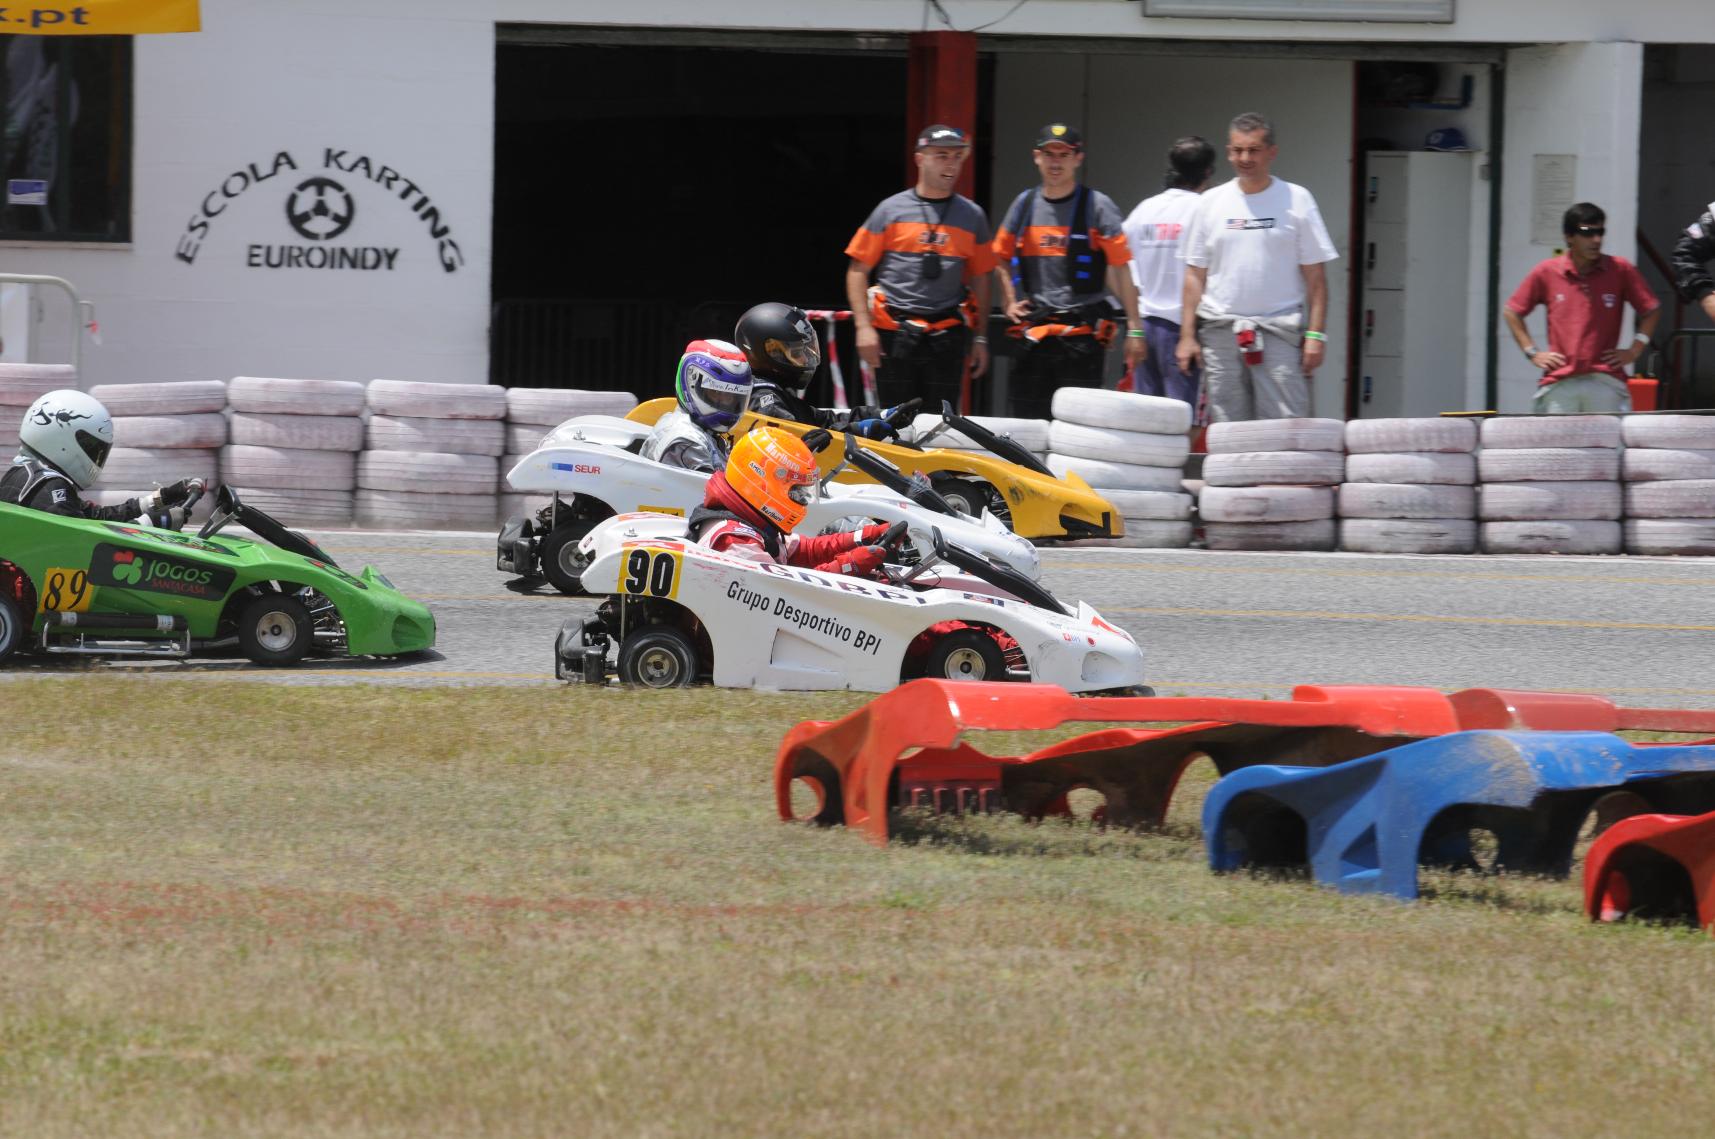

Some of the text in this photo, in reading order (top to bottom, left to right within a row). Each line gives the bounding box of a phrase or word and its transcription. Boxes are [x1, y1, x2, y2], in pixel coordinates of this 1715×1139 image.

[175, 147, 465, 273] ESCOLA KARTING
[246, 244, 400, 270] EUROINDY
[574, 464, 601, 475] SEUR
[44, 569, 88, 611] 89
[145, 561, 214, 585] JOGOS
[625, 548, 676, 598] 90
[726, 580, 882, 656] Grupo Desportivo BPI
